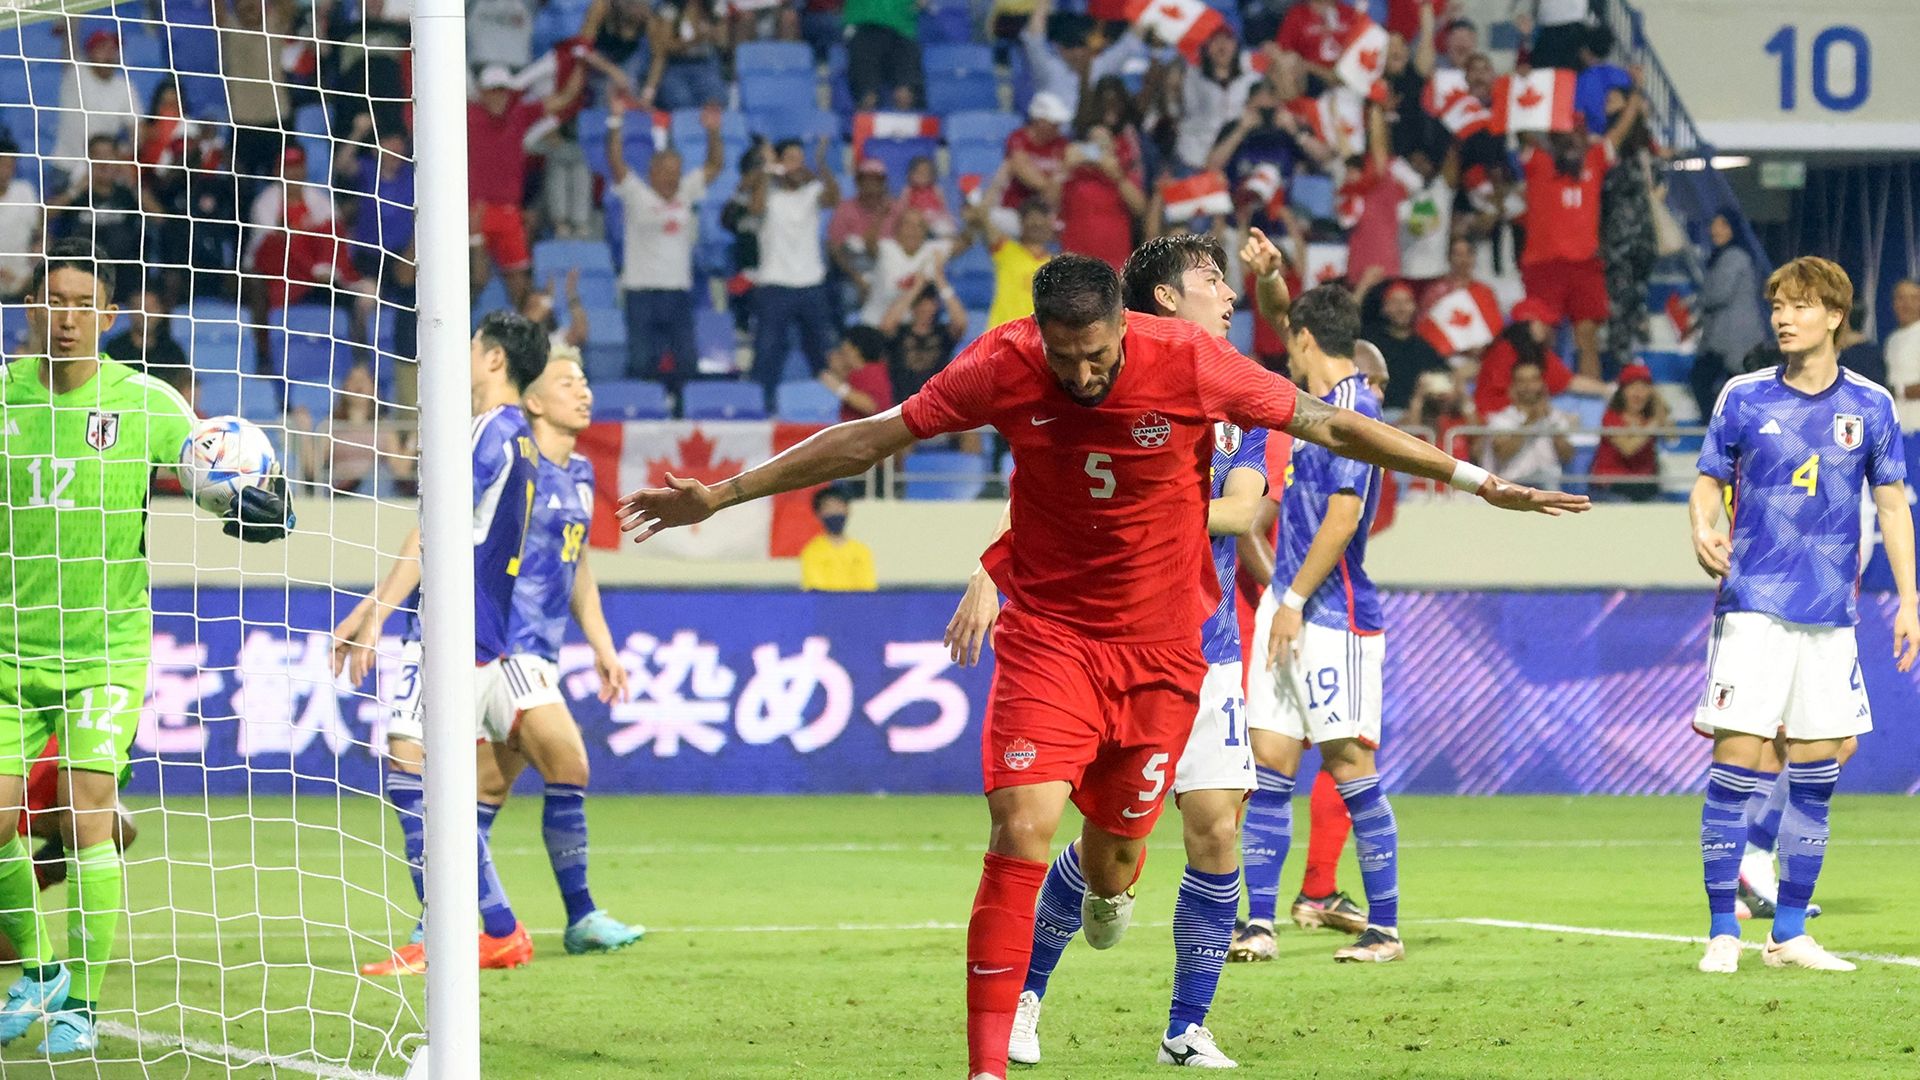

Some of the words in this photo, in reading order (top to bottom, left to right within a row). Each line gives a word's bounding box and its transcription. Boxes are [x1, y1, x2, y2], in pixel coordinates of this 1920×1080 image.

[1764, 23, 1871, 113] 10
[1132, 426, 1169, 436] CANADA
[27, 457, 76, 508] 12
[1084, 452, 1116, 499] 5
[1792, 453, 1819, 496] 4
[394, 665, 418, 700] 3
[1305, 667, 1340, 709] 19
[76, 685, 129, 735] 12
[1005, 751, 1036, 759] CANADA
[1138, 752, 1169, 801] 5
